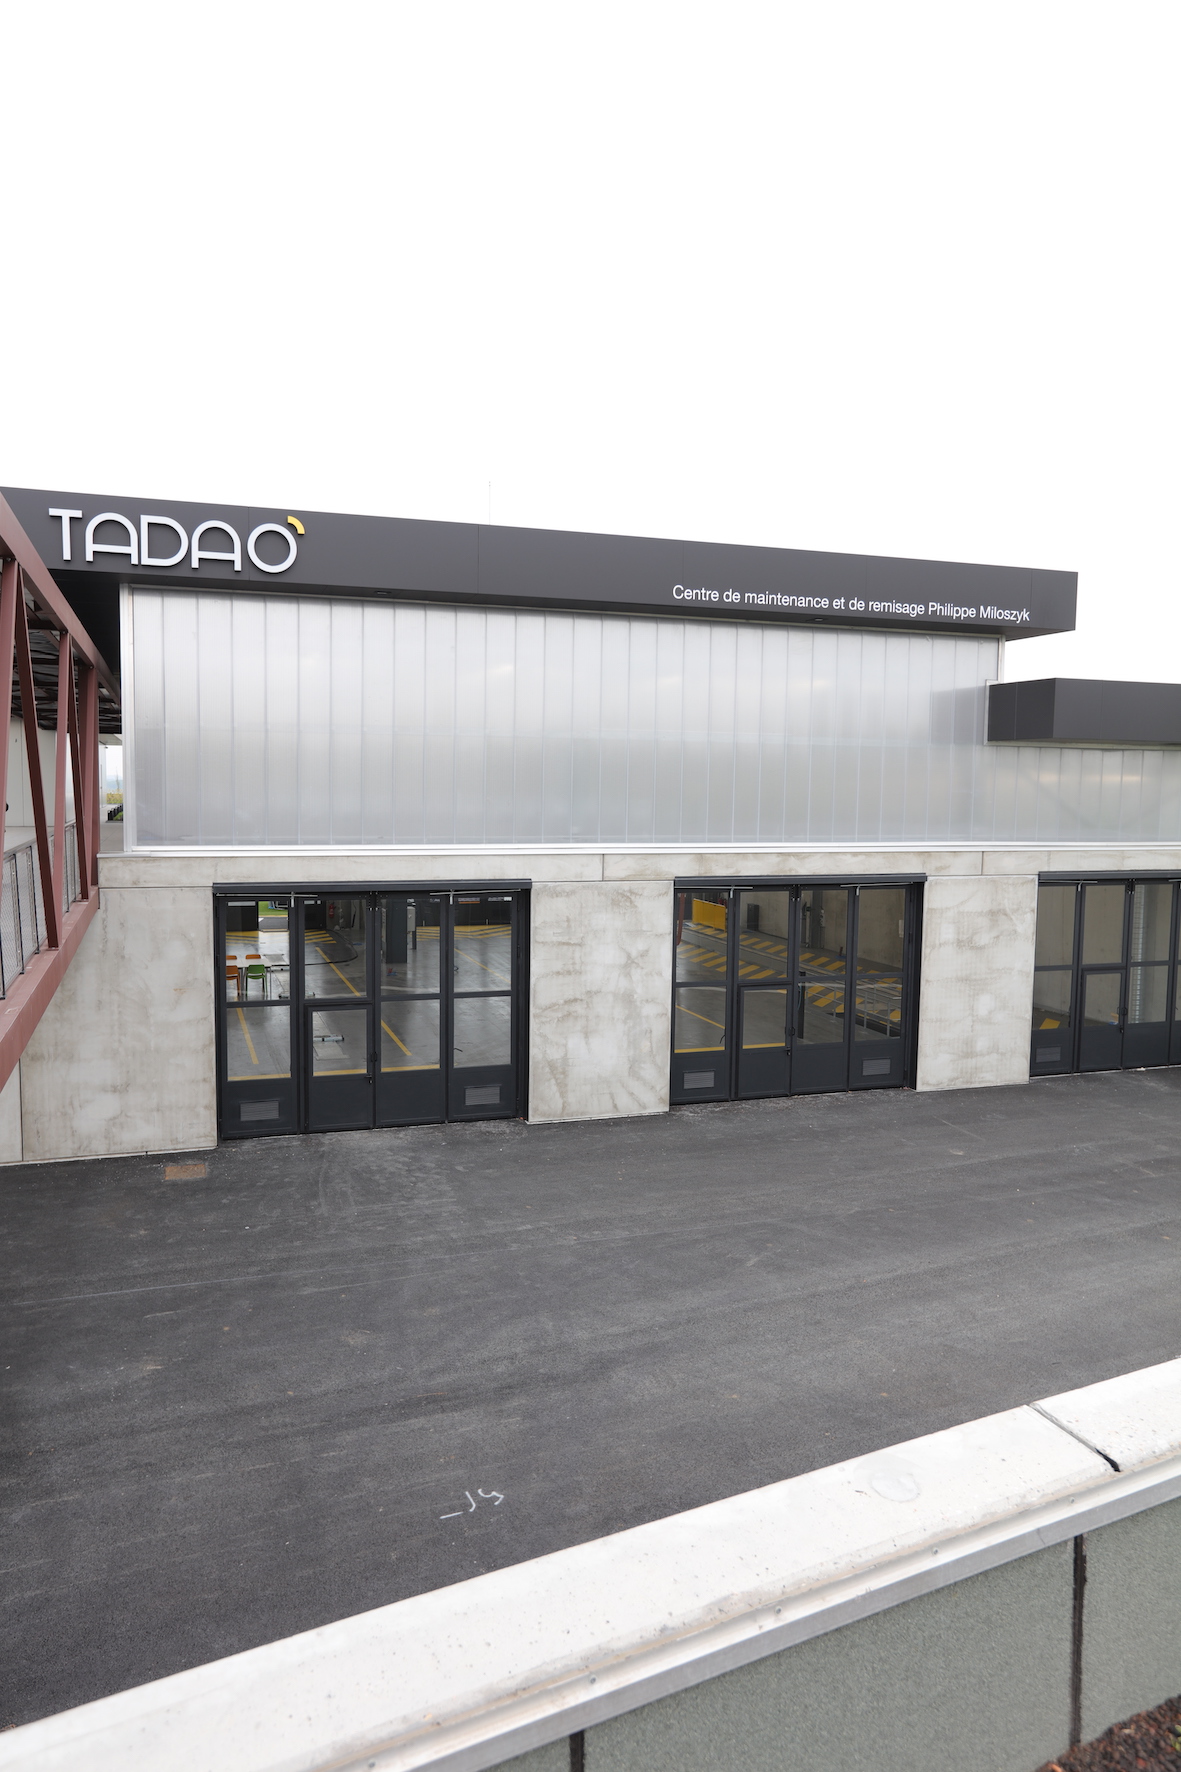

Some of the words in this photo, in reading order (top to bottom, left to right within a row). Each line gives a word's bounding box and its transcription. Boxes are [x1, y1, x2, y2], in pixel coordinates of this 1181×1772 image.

[48, 507, 299, 574] TADAO
[672, 584, 719, 602] Centre
[722, 588, 741, 603] de
[744, 591, 829, 609] maintenance
[832, 597, 846, 610] et
[848, 597, 865, 611] de
[868, 600, 925, 618] remisage
[928, 602, 976, 620] Philippe
[979, 605, 1030, 624] Miloszyk
